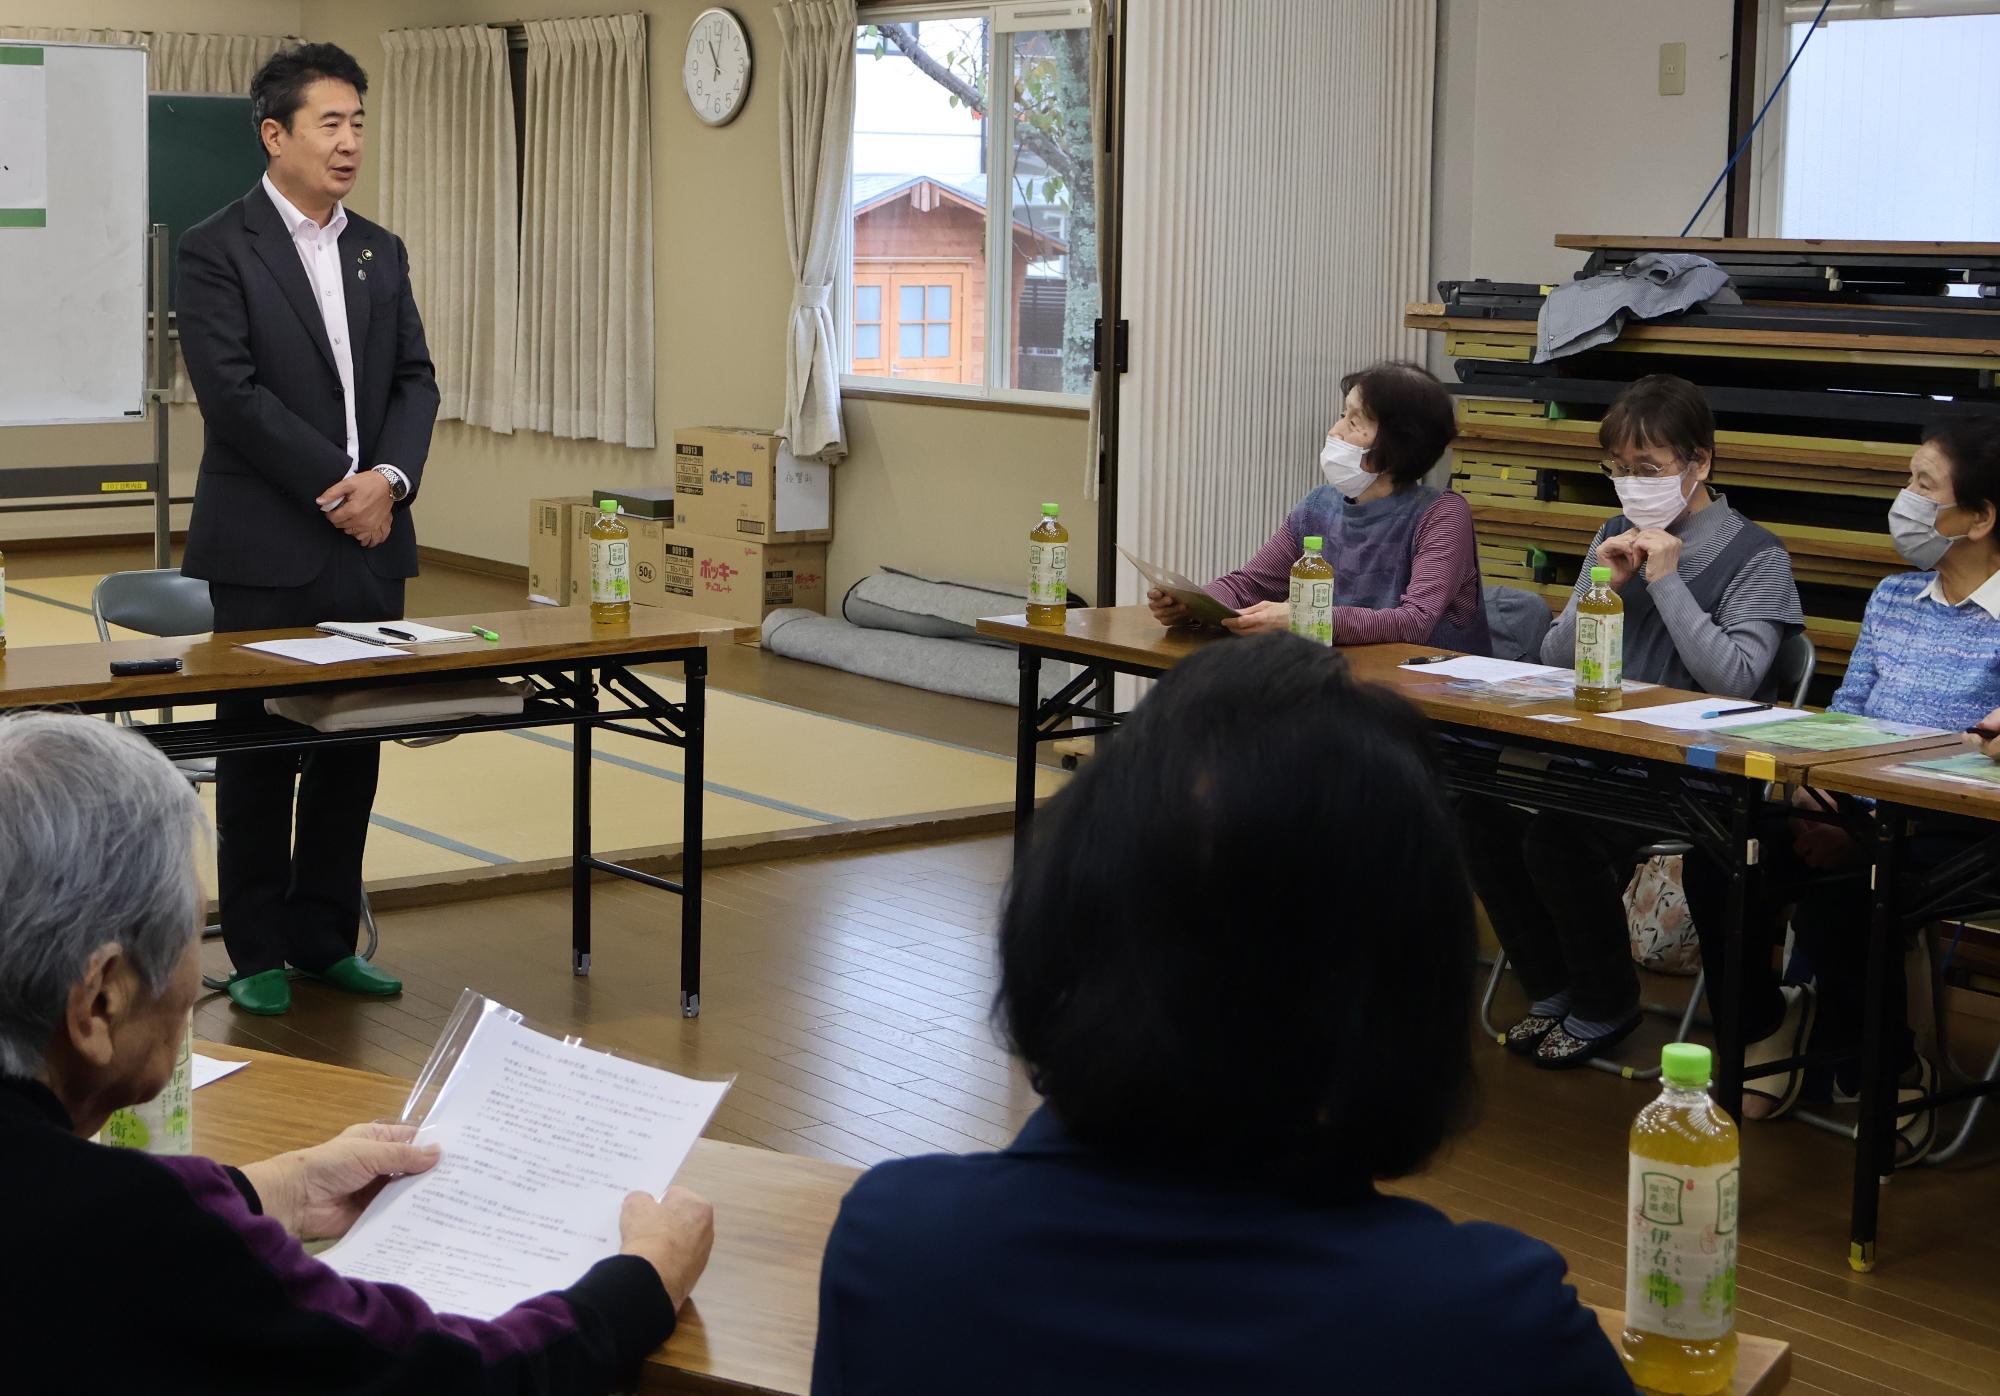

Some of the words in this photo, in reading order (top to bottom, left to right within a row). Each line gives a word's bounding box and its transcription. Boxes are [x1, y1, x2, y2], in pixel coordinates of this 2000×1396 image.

[704, 26, 712, 41] 11
[695, 39, 705, 55] 10
[733, 36, 742, 52] 2
[691, 59, 699, 76] 9
[738, 57, 745, 74] 3
[695, 79, 703, 96] 8
[733, 79, 740, 94] 4
[704, 93, 711, 110] 7
[714, 97, 721, 114] 6
[725, 92, 732, 110] 5
[638, 565, 653, 580] 50g
[700, 558, 739, 582] ポッキー
[172, 1069, 185, 1138] 伊右衛門
[1649, 1227, 1673, 1309] 伊右衛門
